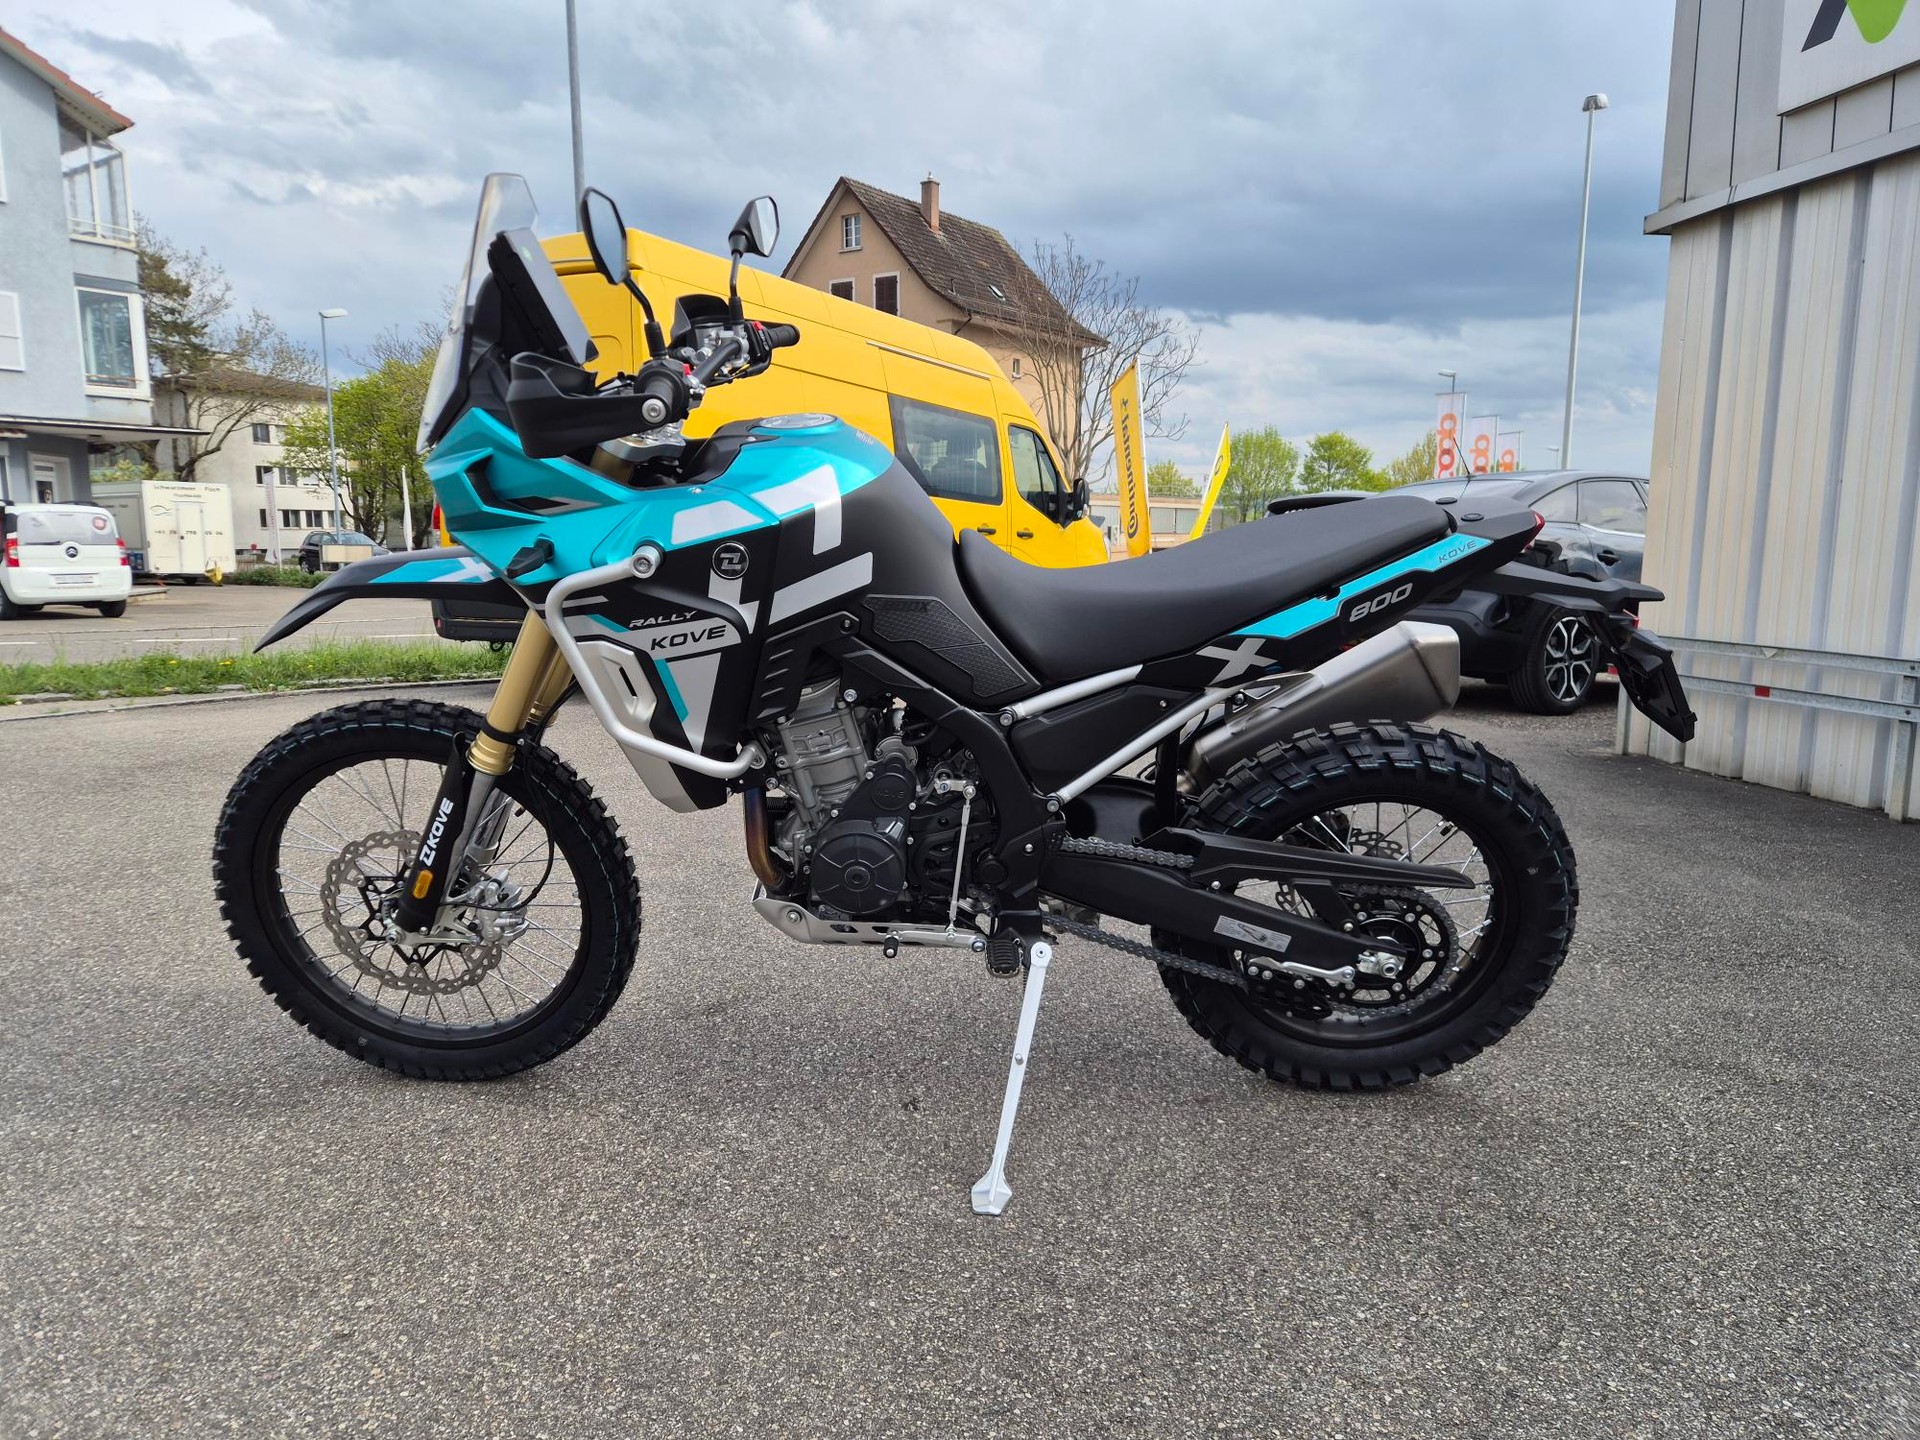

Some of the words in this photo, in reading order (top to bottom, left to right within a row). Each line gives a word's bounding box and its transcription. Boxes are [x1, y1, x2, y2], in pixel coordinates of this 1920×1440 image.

[1437, 540, 1477, 563] KOVE
[1349, 583, 1414, 622] 800
[629, 610, 698, 628] RALLY
[650, 625, 727, 651] KOVE
